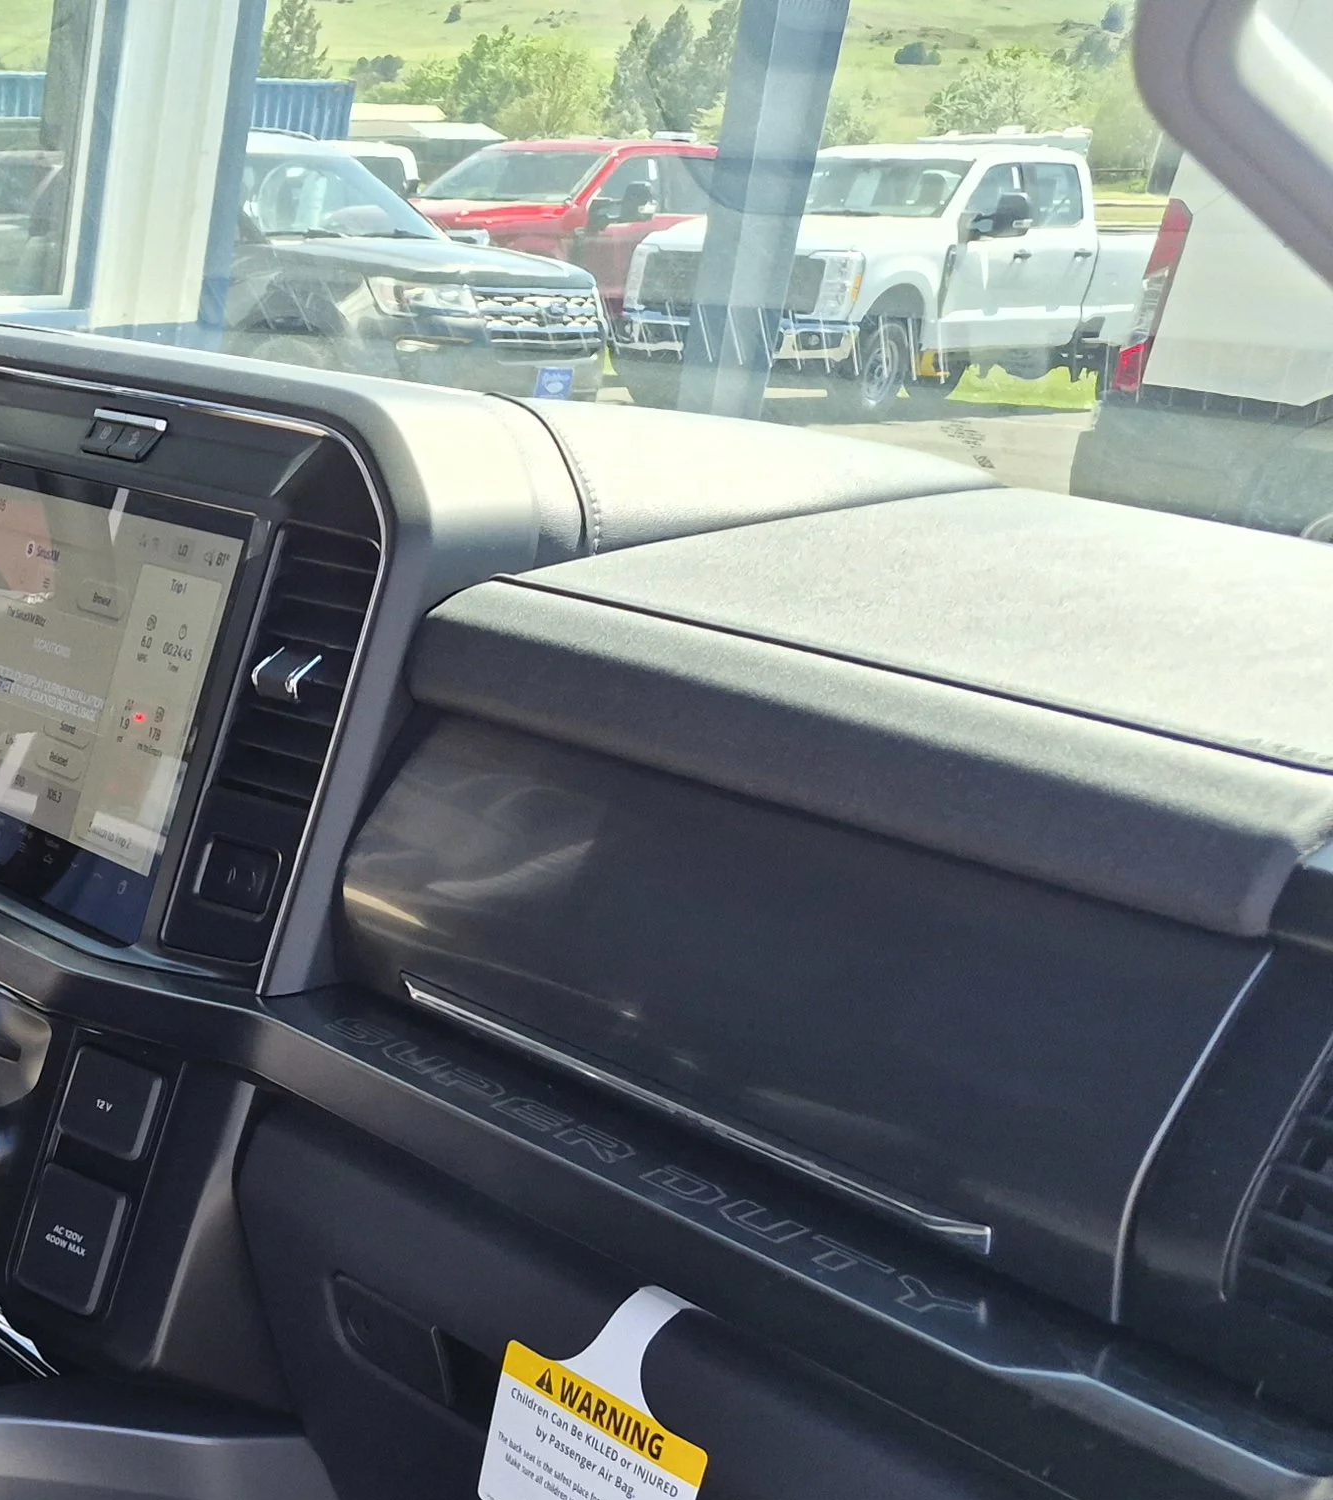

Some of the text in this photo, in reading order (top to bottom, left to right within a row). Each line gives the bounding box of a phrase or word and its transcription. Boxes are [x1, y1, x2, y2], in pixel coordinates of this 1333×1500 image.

[325, 1017, 986, 1313] SUPER DUTY
[45, 1233, 86, 1257] 400W MAX
[53, 1224, 84, 1244] AC 120V
[511, 1387, 679, 1498] Children Can Be KILLED or INJURED
[559, 1376, 665, 1461] WARNING
[498, 1431, 508, 1445] The
[508, 1437, 523, 1455] back
[523, 1448, 536, 1462] seat
[542, 1461, 554, 1475] the
[554, 1468, 572, 1487] safest
[572, 1479, 590, 1500] place
[505, 1453, 521, 1470] Make
[521, 1464, 535, 1480] sure
[535, 1471, 543, 1485] all
[535, 1425, 636, 1500] by Passenger Air Bag.
